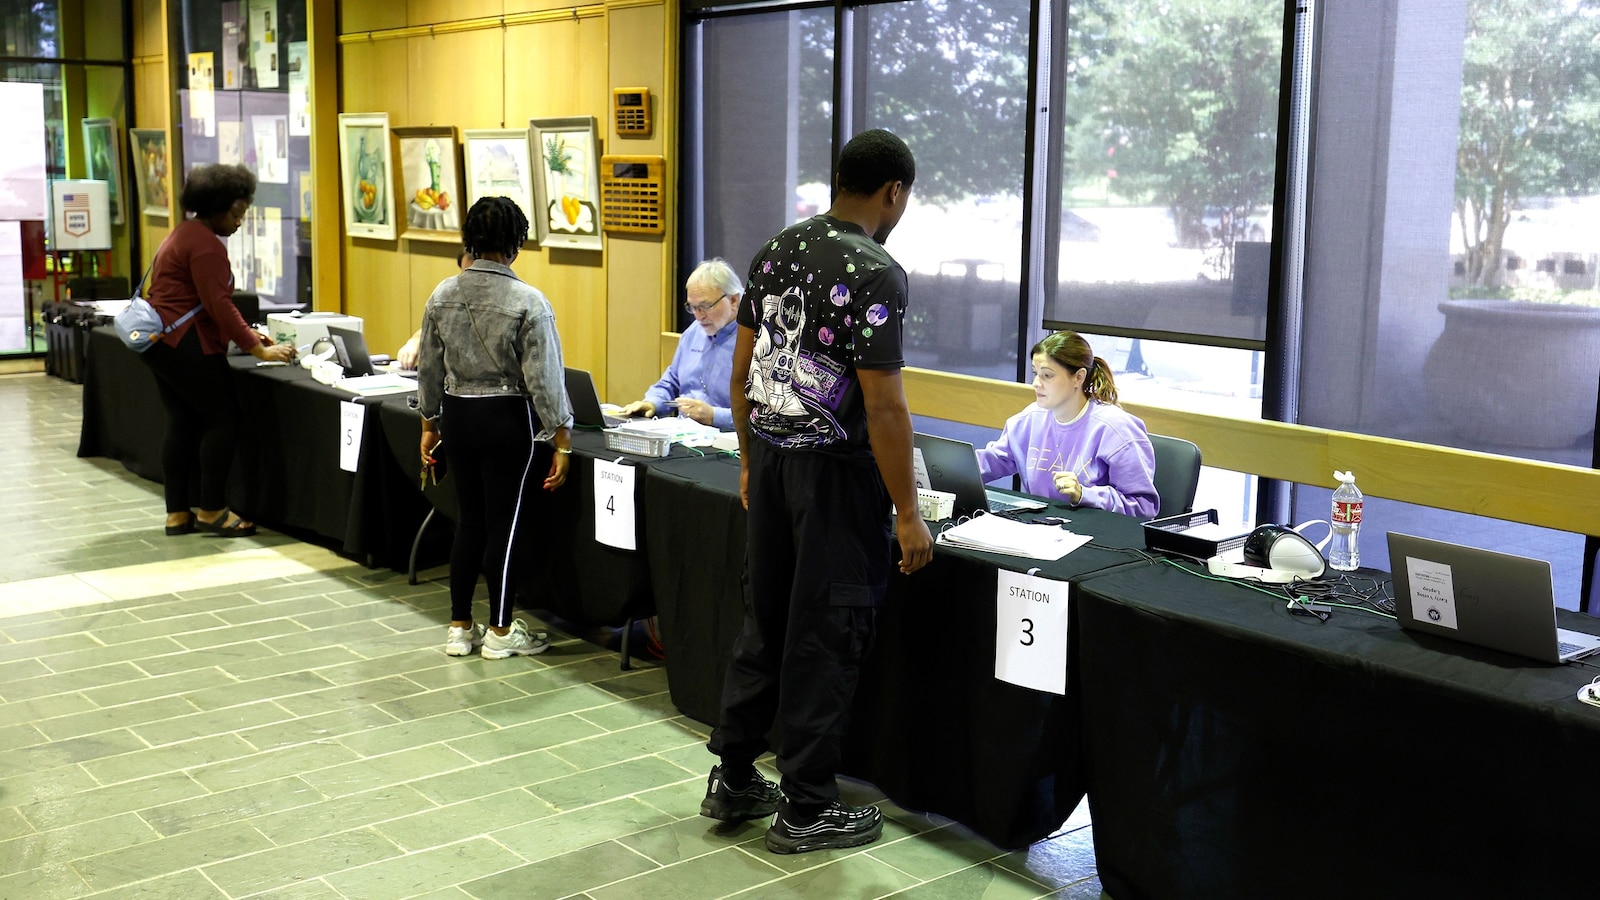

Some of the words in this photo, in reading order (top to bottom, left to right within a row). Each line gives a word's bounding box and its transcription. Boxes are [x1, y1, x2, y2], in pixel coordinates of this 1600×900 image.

[346, 428, 353, 446] 5
[601, 470, 624, 484] STATION
[606, 495, 616, 516] 4
[1009, 586, 1050, 604] STATION
[1422, 586, 1441, 595] Laptop
[1020, 618, 1034, 646] 3
